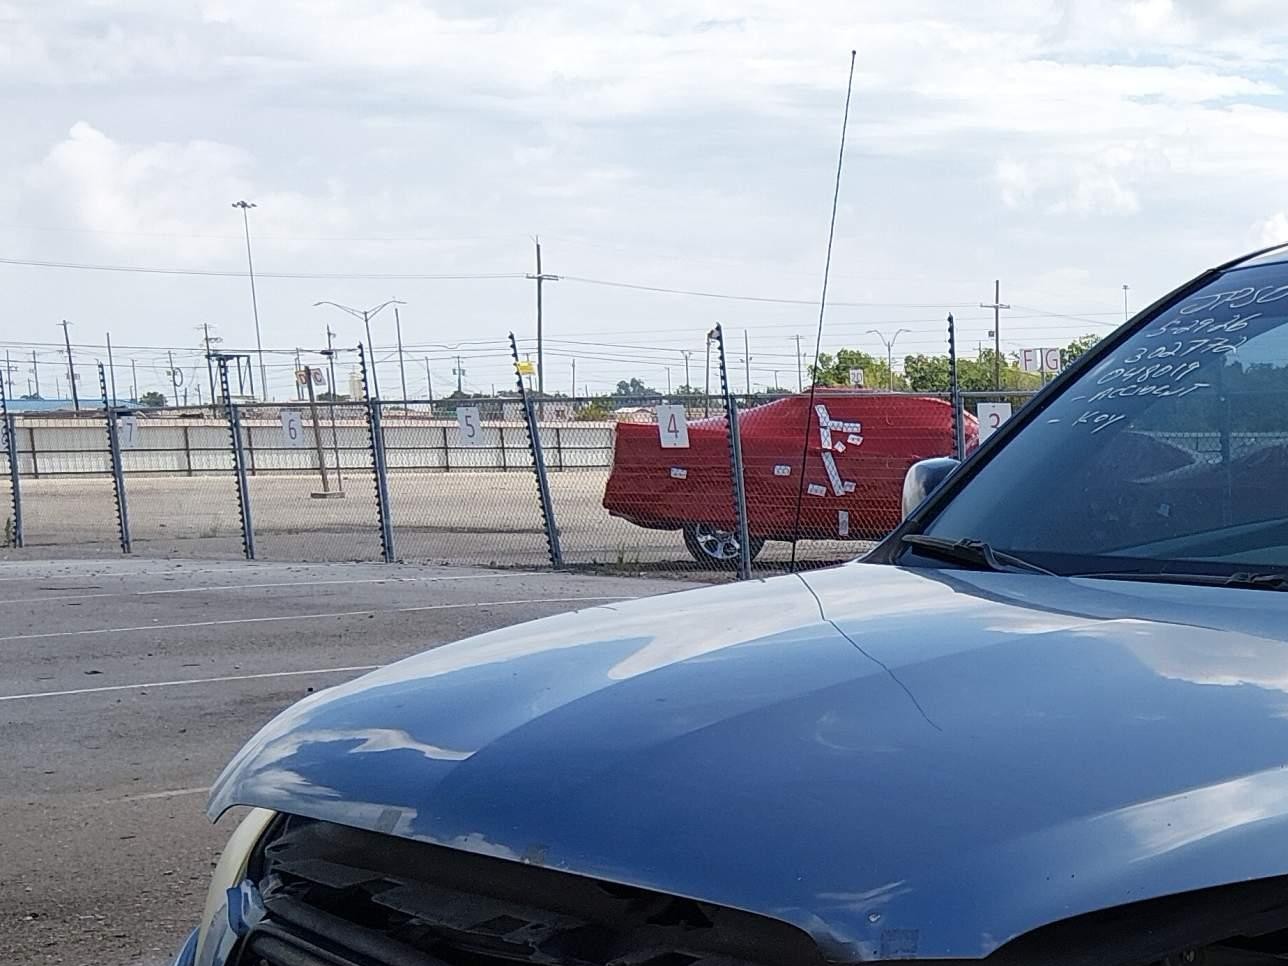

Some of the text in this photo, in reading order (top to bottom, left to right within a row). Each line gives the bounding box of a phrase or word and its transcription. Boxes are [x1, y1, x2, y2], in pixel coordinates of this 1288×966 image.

[1124, 336, 1247, 364] 302772
[127, 423, 132, 441] 7
[288, 419, 297, 440] 6
[465, 416, 475, 438] 5
[667, 414, 679, 439] 4
